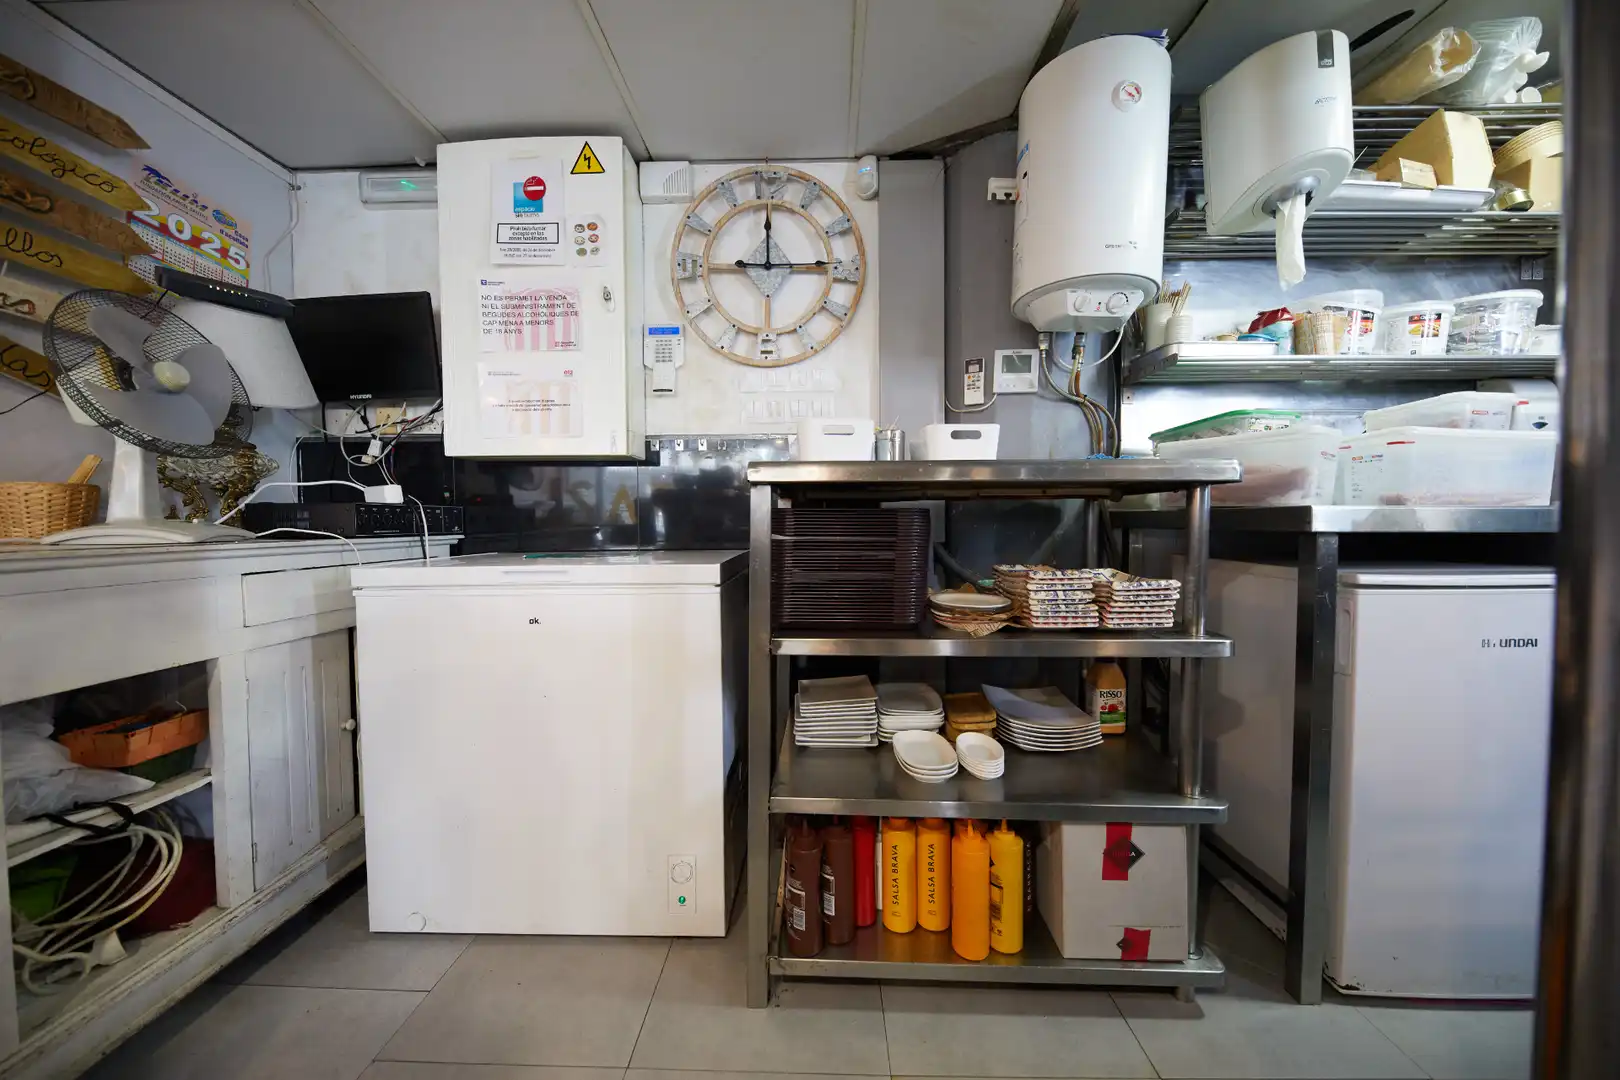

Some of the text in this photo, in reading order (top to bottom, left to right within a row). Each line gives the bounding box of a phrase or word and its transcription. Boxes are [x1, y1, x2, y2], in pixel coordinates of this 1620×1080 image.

[132, 195, 249, 270] 2025
[1099, 690, 1123, 699] RISSO
[891, 844, 899, 874] BRAVA
[927, 843, 935, 873] BRAVA
[892, 878, 900, 906] SALSA
[927, 876, 936, 905] SALSA
